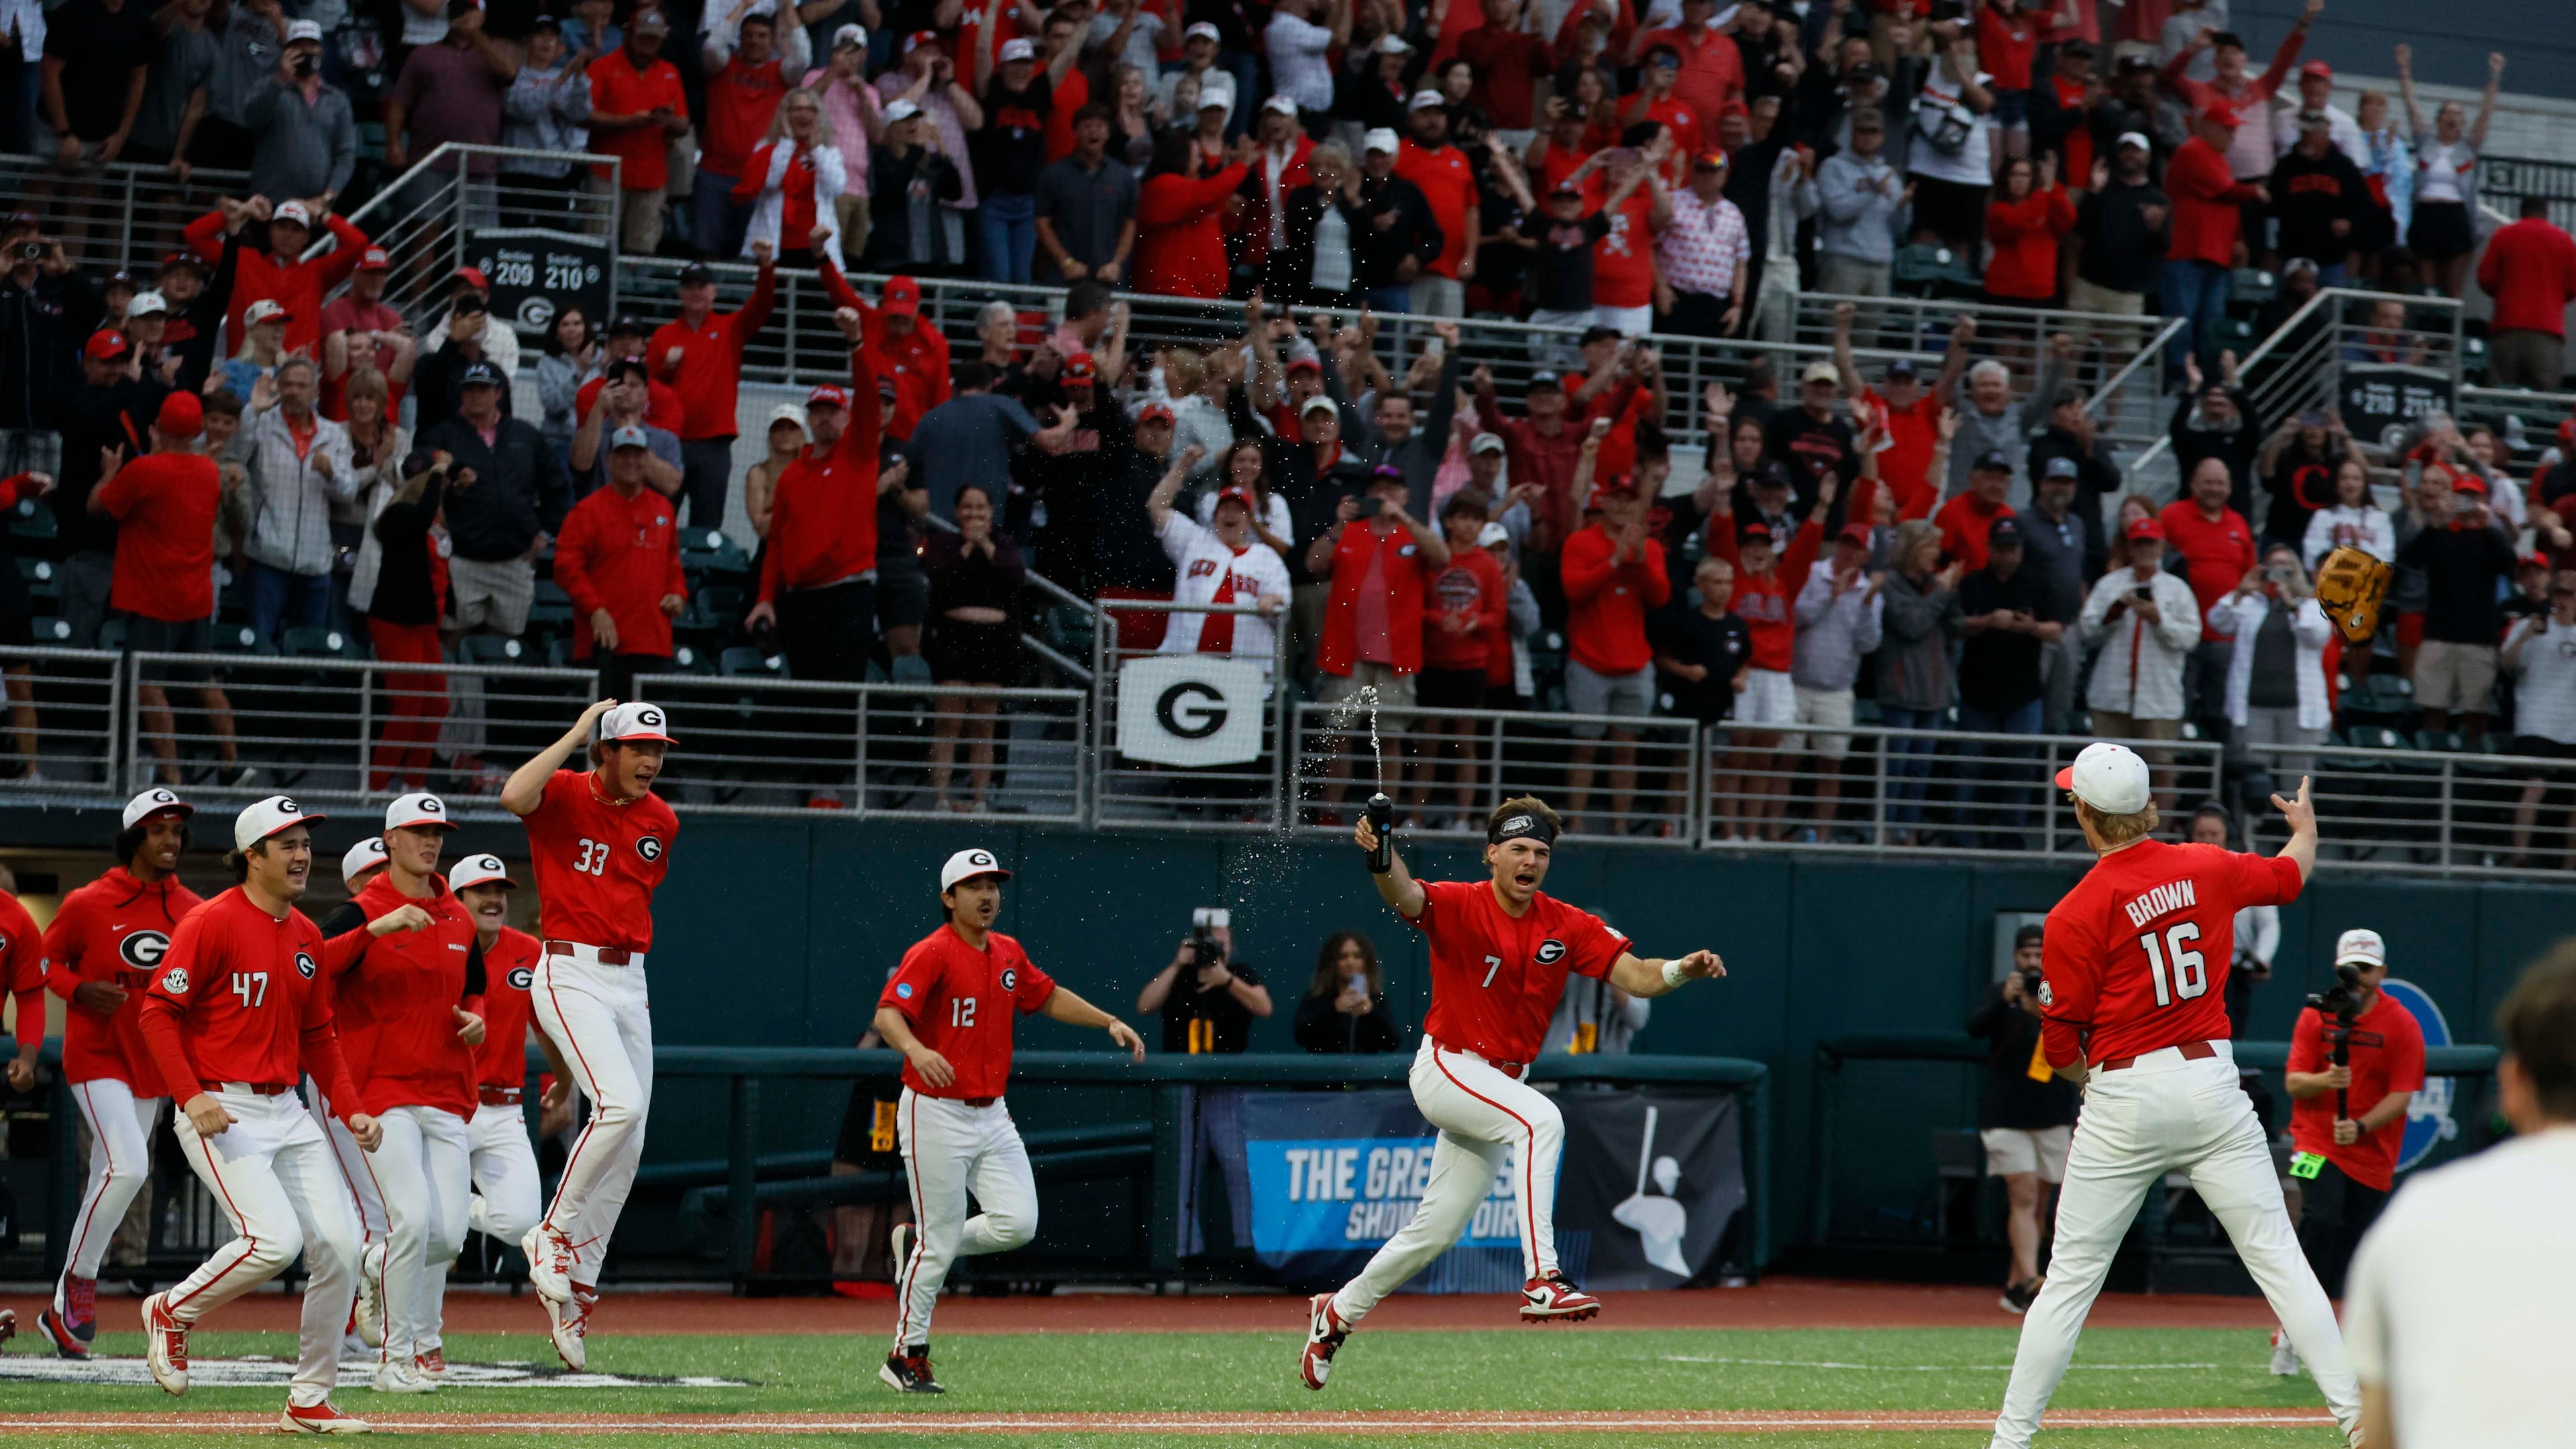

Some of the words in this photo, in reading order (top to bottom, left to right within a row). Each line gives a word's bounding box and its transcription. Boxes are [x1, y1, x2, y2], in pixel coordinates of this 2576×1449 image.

[497, 248, 534, 262] Section
[546, 252, 583, 266] Section
[495, 261, 535, 287] 209
[544, 266, 584, 291] 210
[638, 710, 661, 726] G
[1157, 682, 1227, 739] G
[153, 791, 172, 802] G
[278, 798, 298, 814] G
[419, 798, 440, 812] G
[574, 838, 610, 876] 33
[636, 836, 661, 862] G
[970, 853, 991, 865] G
[479, 858, 500, 870] G
[2125, 879, 2196, 928] BROWN
[119, 930, 170, 970] G
[1534, 938, 1566, 965] G
[294, 952, 316, 980] G
[1482, 955, 1502, 988] 7
[2140, 921, 2208, 1007] 16
[168, 969, 187, 987] SEC
[232, 971, 268, 1008] 47
[506, 967, 533, 991] G
[1000, 968, 1016, 991] G
[952, 997, 977, 1028] 12
[1285, 1148, 1360, 1201] THE
[1364, 1146, 1514, 1199] GRES
[1470, 1199, 1518, 1239] DIR
